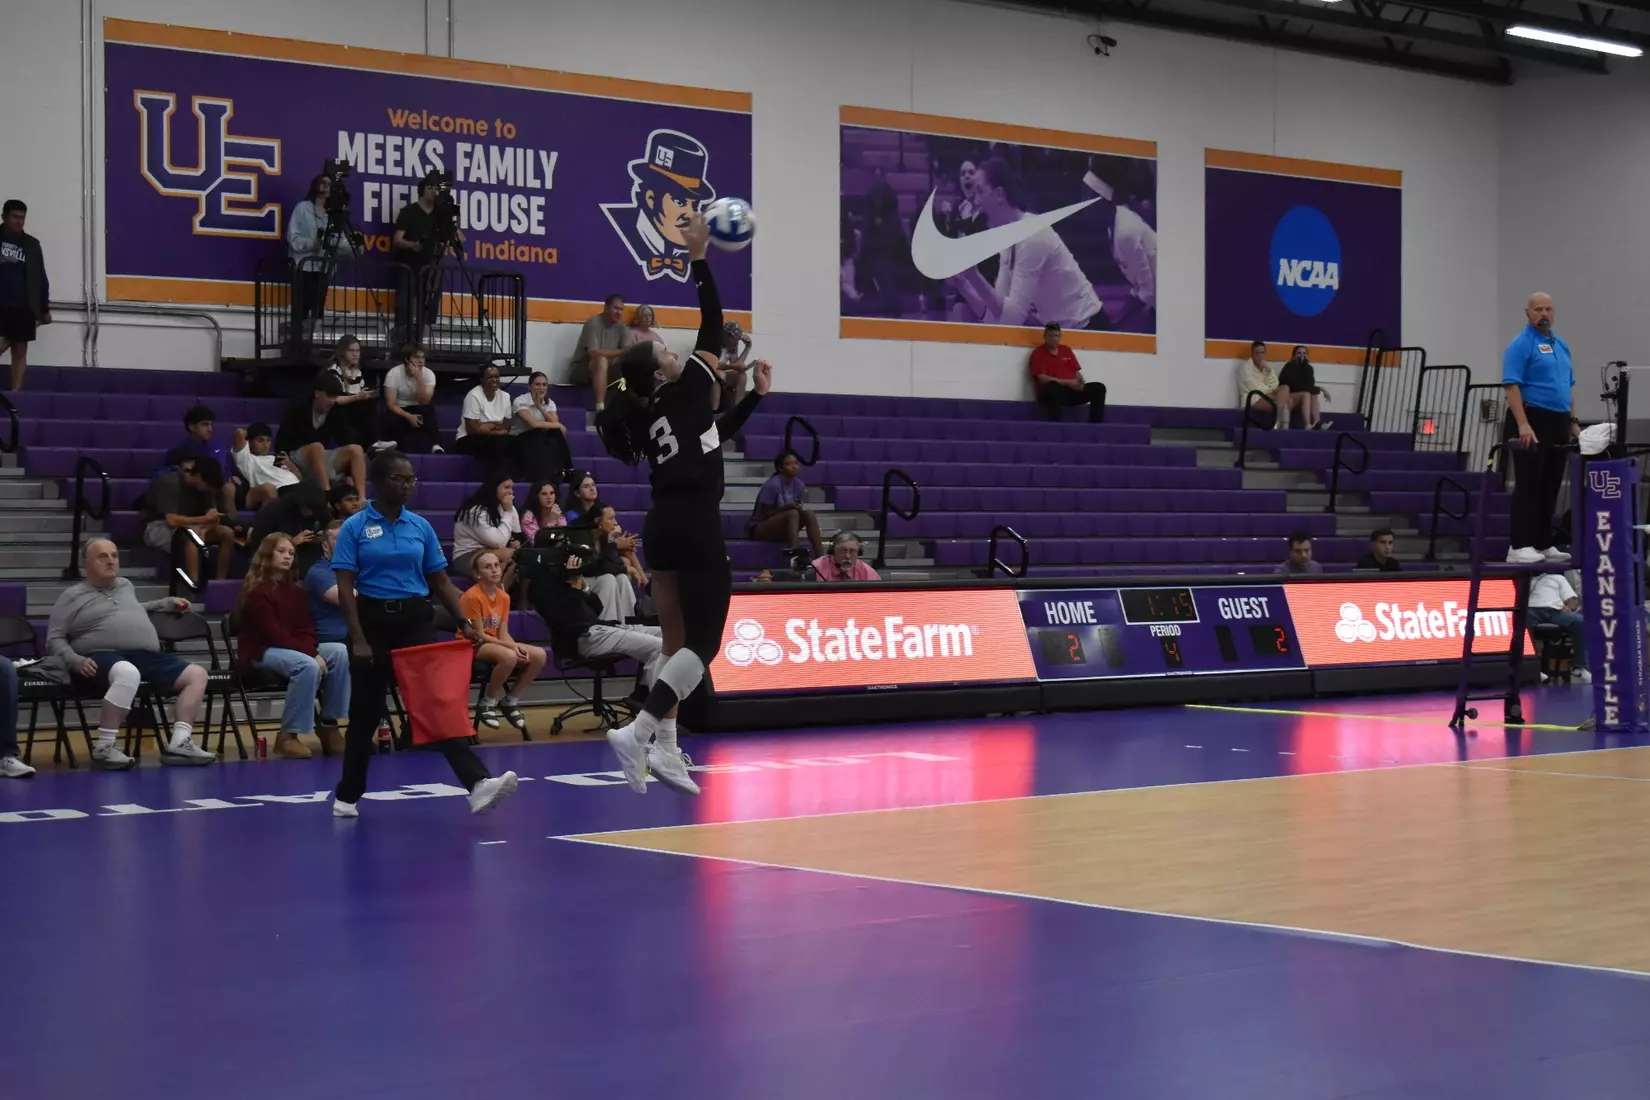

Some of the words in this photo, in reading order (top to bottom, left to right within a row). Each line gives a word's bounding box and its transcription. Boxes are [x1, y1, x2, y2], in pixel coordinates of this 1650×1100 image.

[387, 107, 489, 137] Welcome
[494, 117, 517, 140] to
[134, 89, 281, 239] UE
[338, 130, 445, 179] MEEKS
[456, 141, 559, 190] FAMILY
[363, 181, 546, 236] FIEHOUSE
[475, 239, 558, 265] Indiana
[1277, 258, 1339, 290] NCAA
[649, 415, 679, 465] 3
[1588, 470, 1621, 499] UE
[1044, 600, 1097, 625] HOME
[1218, 596, 1270, 620] GUEST
[1596, 511, 1619, 725] EVANSVILLE
[785, 615, 974, 663] StateFarm
[1150, 624, 1182, 637] PERIOD
[1274, 627, 1288, 652] 2
[1067, 634, 1080, 661] 2
